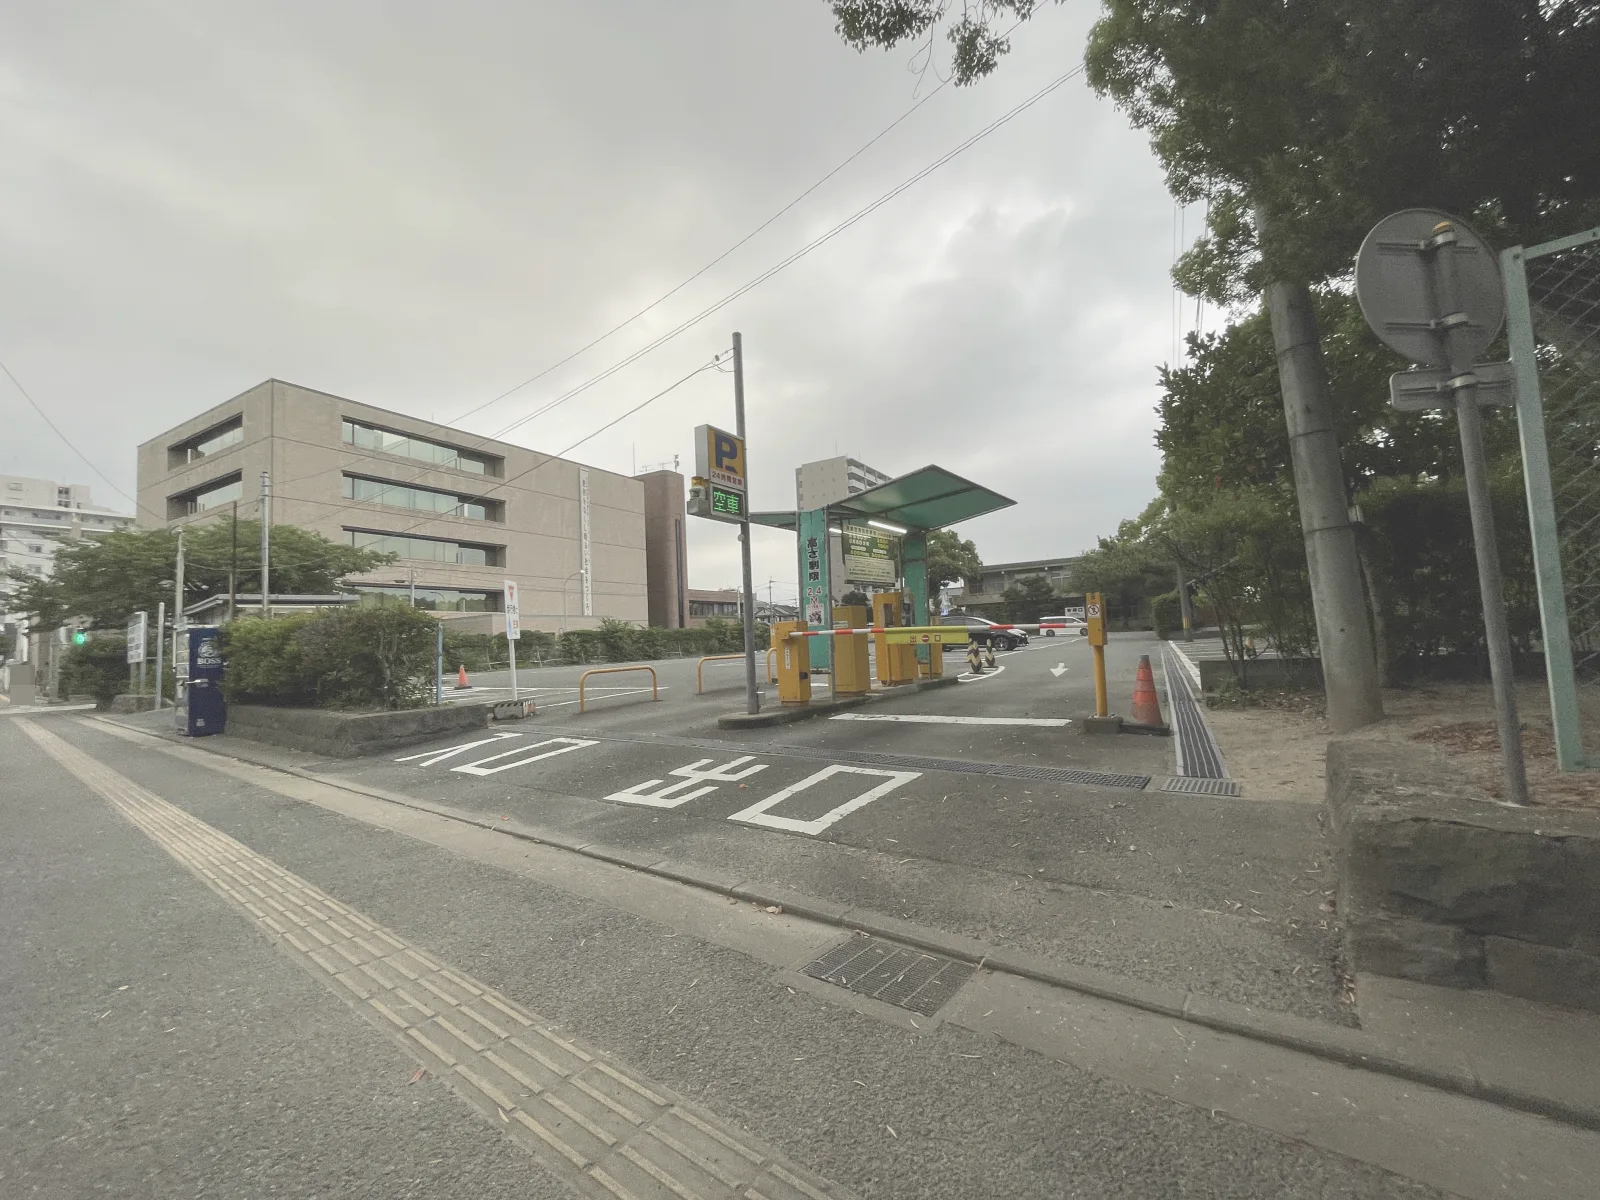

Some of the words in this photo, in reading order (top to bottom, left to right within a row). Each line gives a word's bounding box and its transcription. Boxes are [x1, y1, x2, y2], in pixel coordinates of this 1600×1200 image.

[715, 432, 738, 470] P
[713, 491, 740, 514] 空車
[806, 537, 820, 582] 高さ制限
[197, 657, 221, 665] BOSS
[602, 755, 925, 836] 出口
